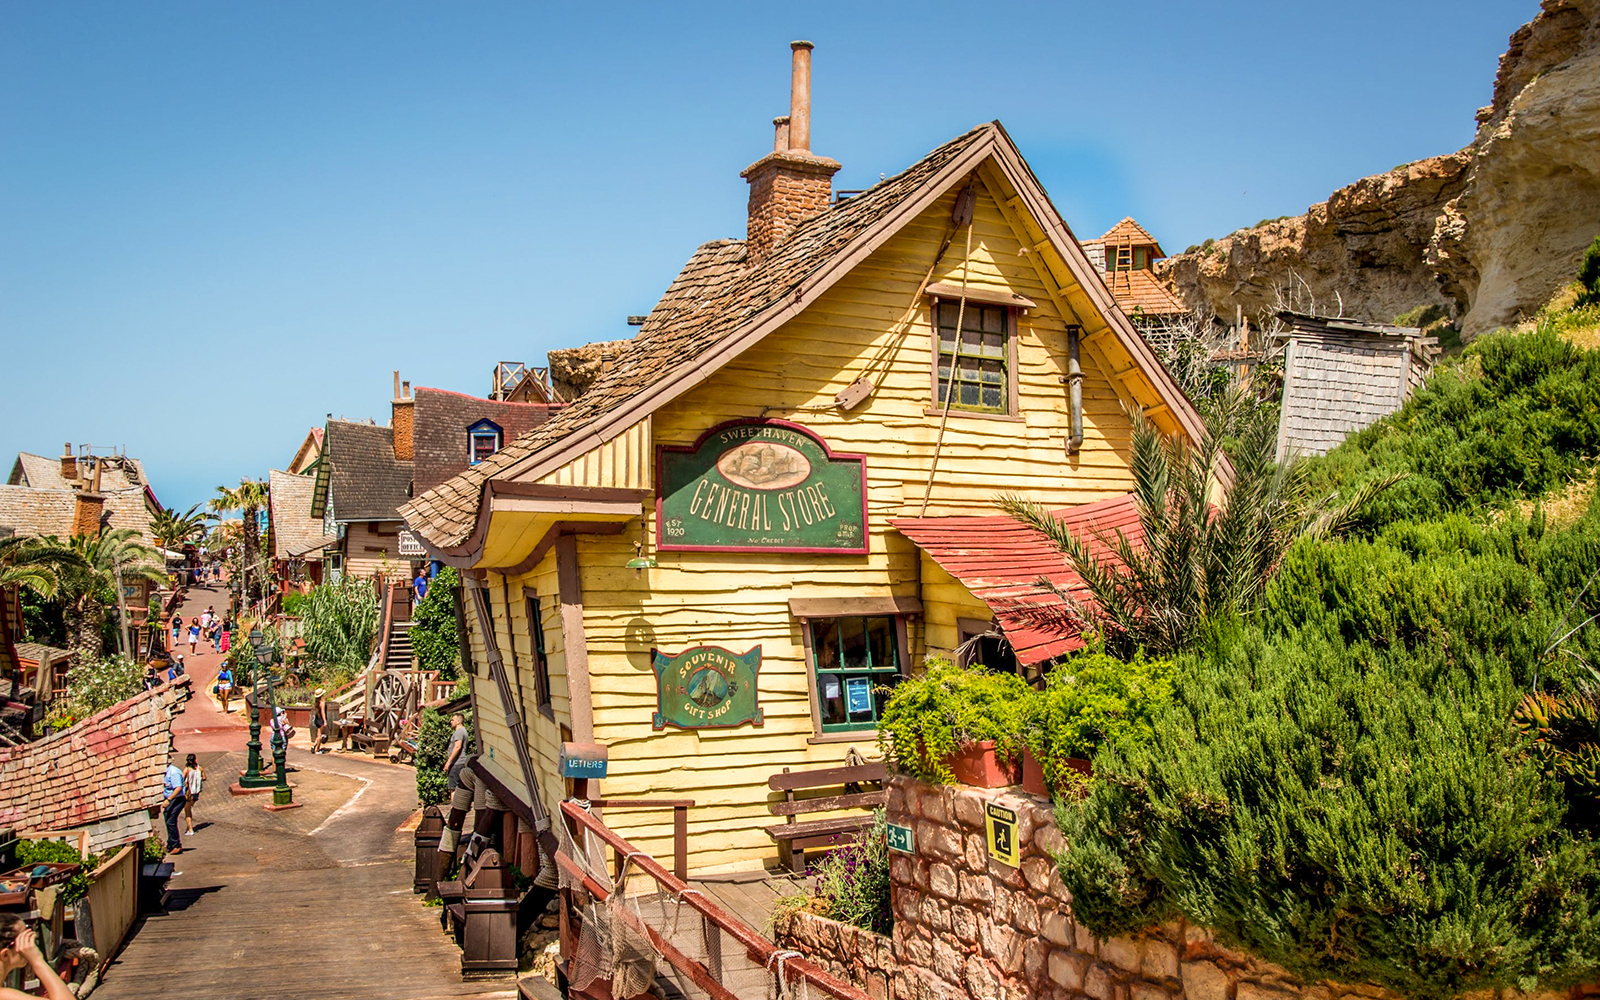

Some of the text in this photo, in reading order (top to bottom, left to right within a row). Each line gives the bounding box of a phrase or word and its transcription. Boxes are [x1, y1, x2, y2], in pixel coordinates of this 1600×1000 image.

[720, 427, 806, 447] SWEETHAVEN
[689, 479, 836, 531] GENERAL STORE
[665, 519, 682, 528] EST
[667, 527, 685, 537] 1920
[679, 653, 736, 679] SOUVENIR
[684, 699, 732, 719] GIFT SHOP
[568, 759, 604, 769] LETTERS
[989, 806, 1013, 821] CAUTION
